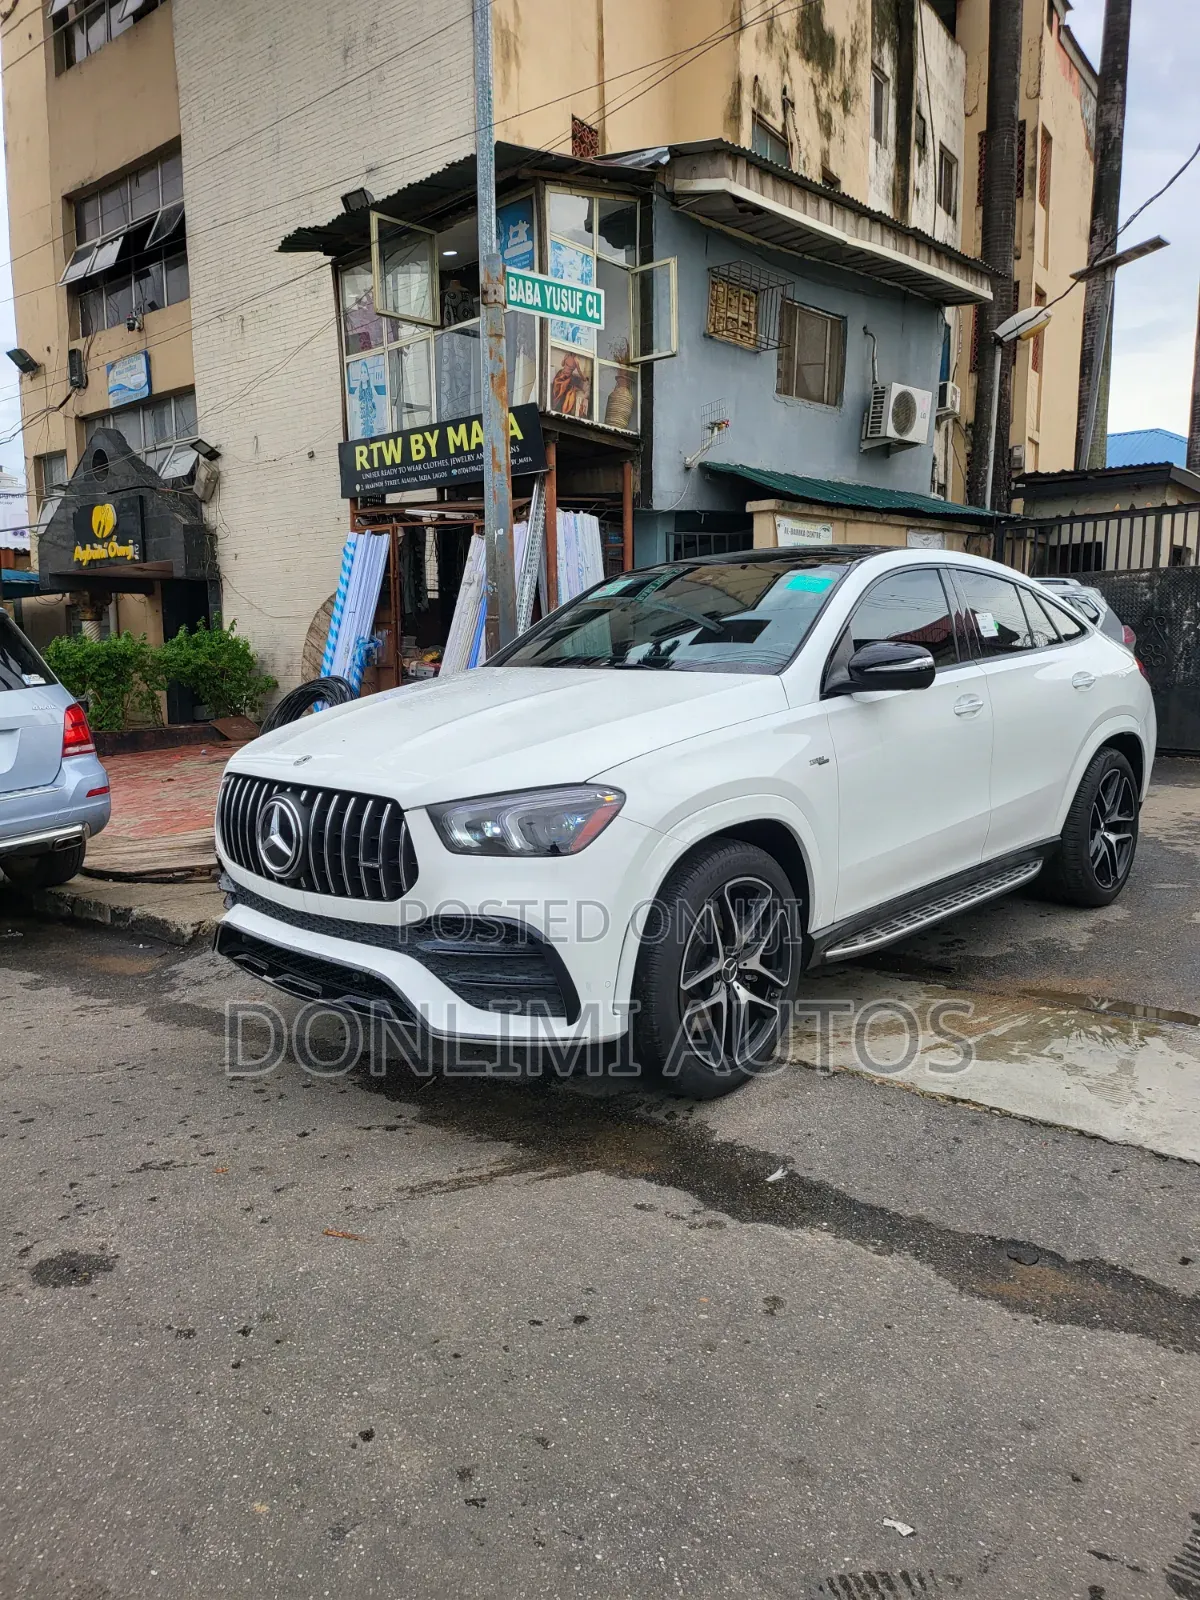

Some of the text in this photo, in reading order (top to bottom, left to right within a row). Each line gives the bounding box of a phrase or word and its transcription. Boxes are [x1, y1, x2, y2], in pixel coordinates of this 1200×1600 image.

[508, 276, 600, 319] BABA YUSUF CL
[355, 412, 524, 471] RTW BY MAA
[381, 468, 398, 477] READY
[399, 466, 407, 474] TO
[407, 464, 422, 472] WEAR
[450, 454, 476, 466] JEWELRY
